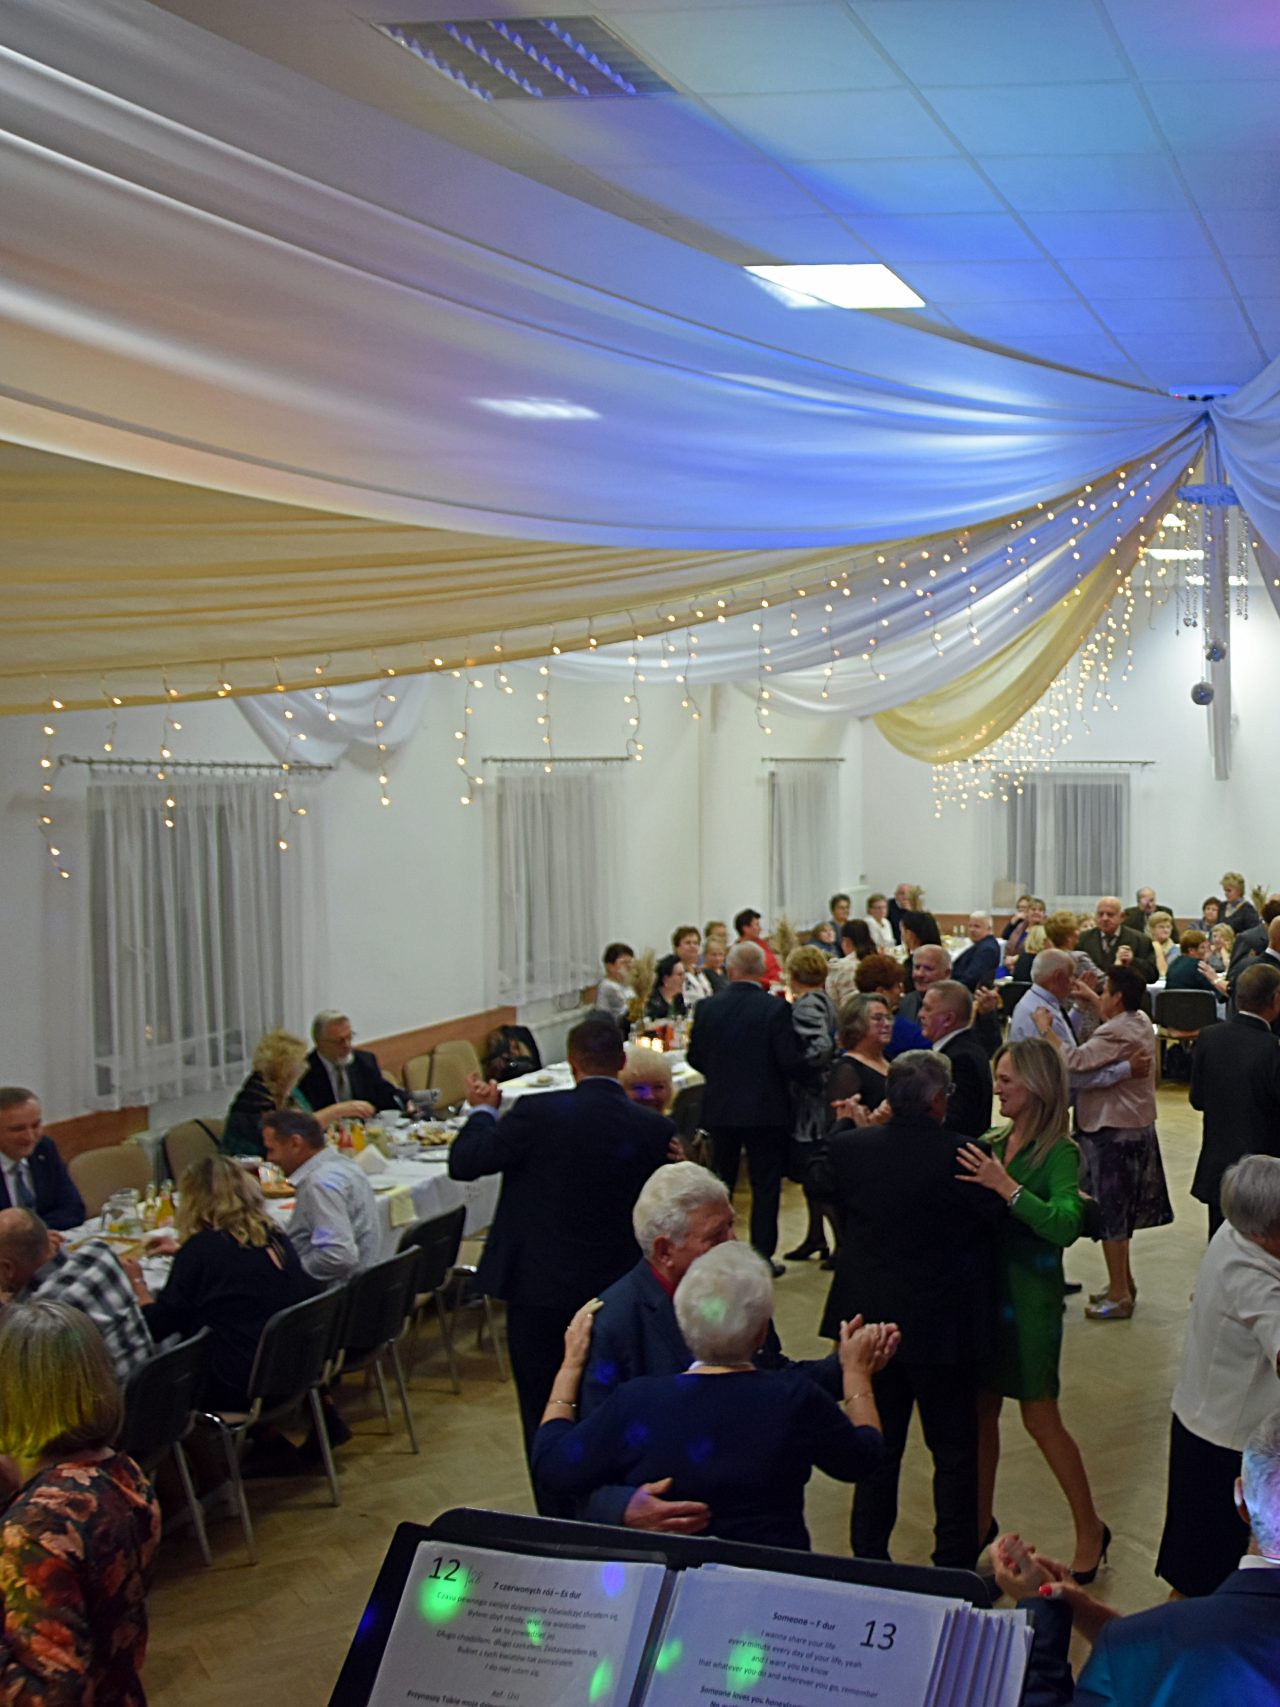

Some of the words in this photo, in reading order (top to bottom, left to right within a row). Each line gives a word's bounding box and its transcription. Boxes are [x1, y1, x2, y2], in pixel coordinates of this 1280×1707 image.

[428, 1556, 460, 1582] 12
[772, 1611, 808, 1626] Someone
[859, 1620, 897, 1650] 13
